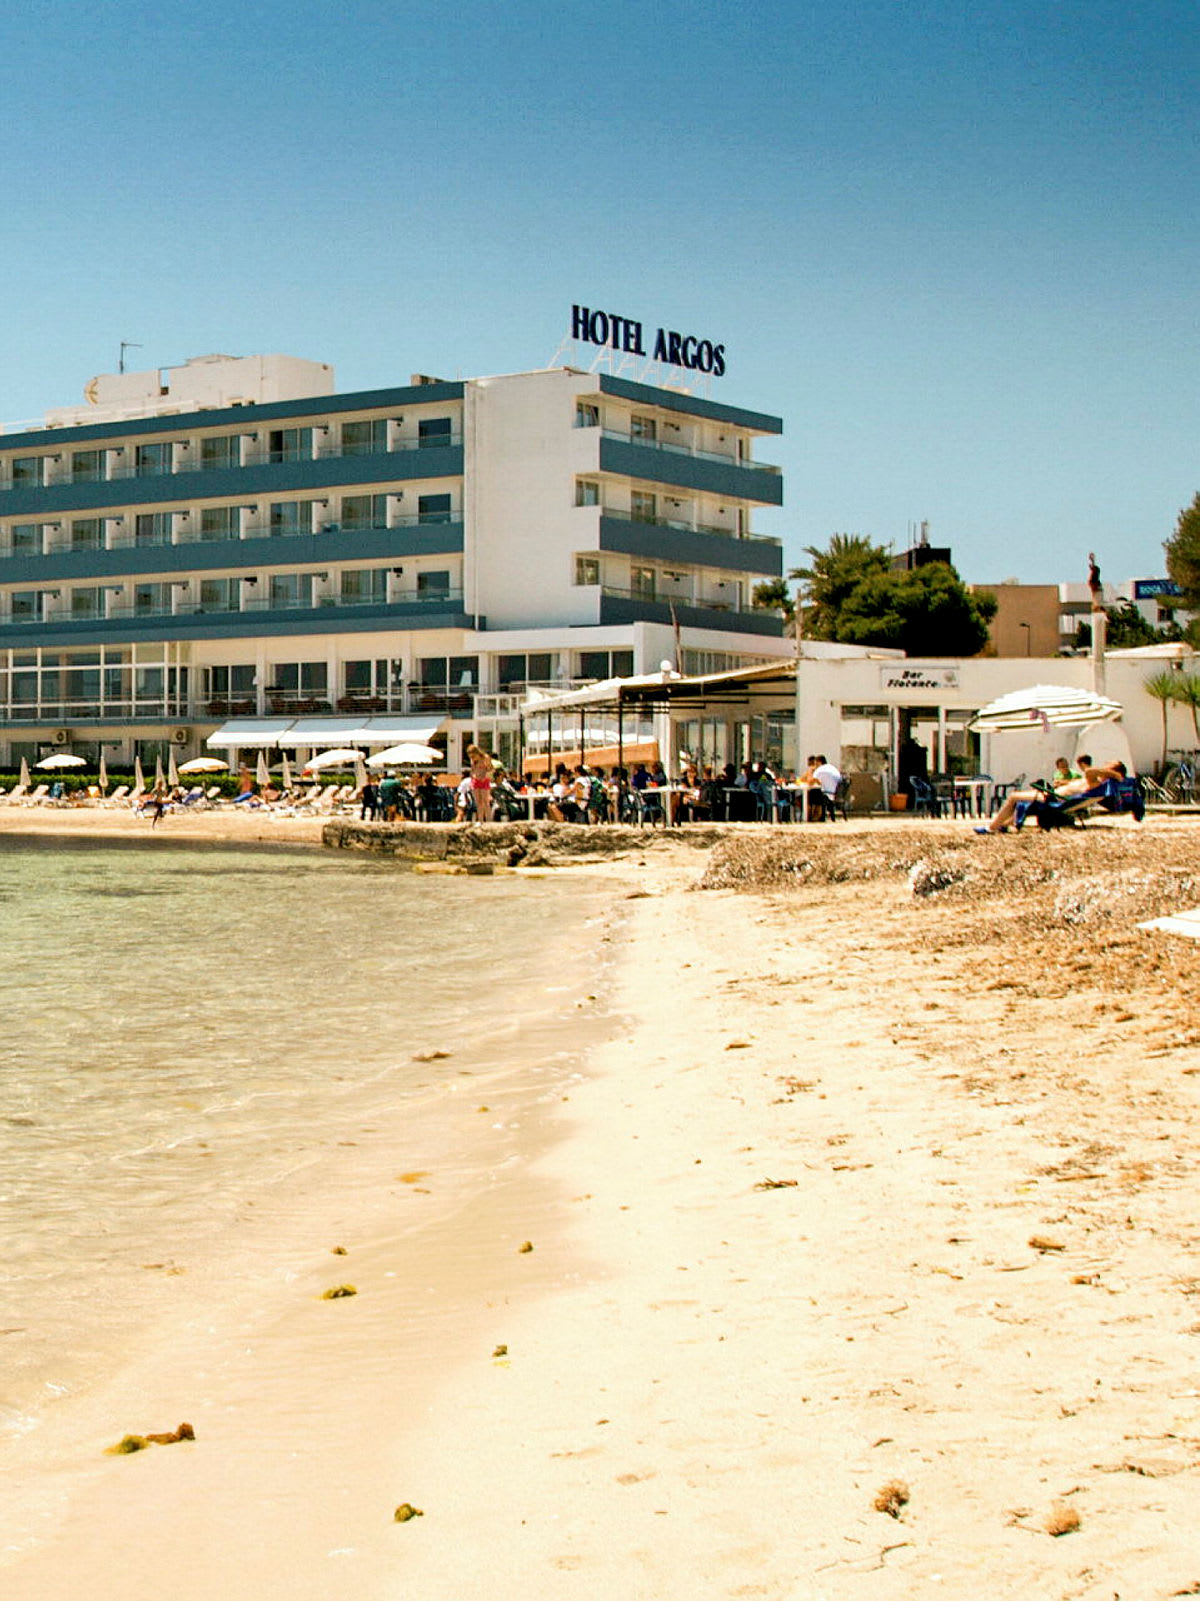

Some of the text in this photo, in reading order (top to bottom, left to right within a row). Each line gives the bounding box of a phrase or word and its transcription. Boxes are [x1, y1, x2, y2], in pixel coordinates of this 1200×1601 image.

[572, 304, 725, 377] HOTEL ARGOS
[902, 670, 923, 680] Bar
